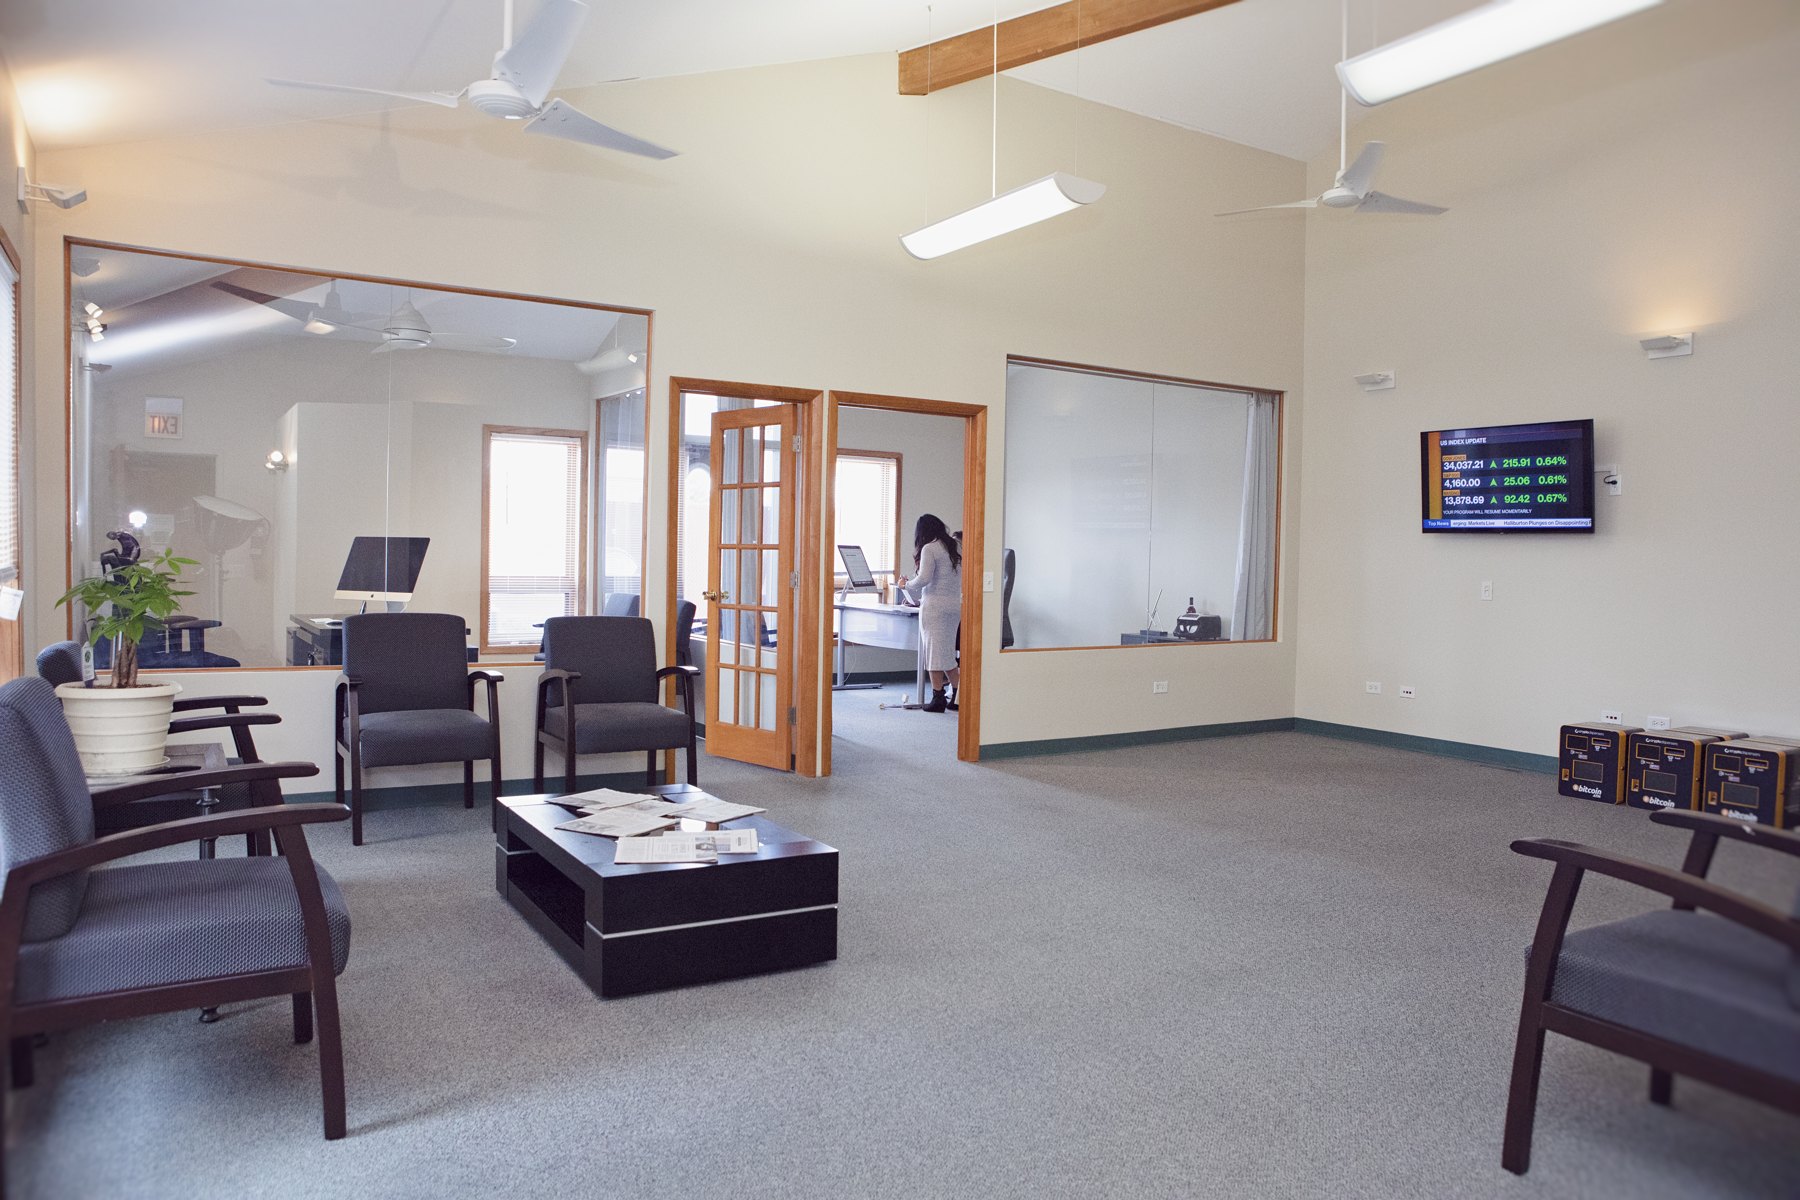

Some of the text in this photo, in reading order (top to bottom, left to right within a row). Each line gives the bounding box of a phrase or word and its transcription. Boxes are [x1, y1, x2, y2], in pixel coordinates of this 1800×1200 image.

[1443, 456, 1567, 471] 34,037.21 215.91 0.64%
[1444, 475, 1567, 489] 4,160.00 25.06 0.61%
[1444, 493, 1567, 506] 13,878.69 92.42 0.67%
[1578, 784, 1602, 795] bitcoin
[1649, 796, 1675, 808] bitcoin
